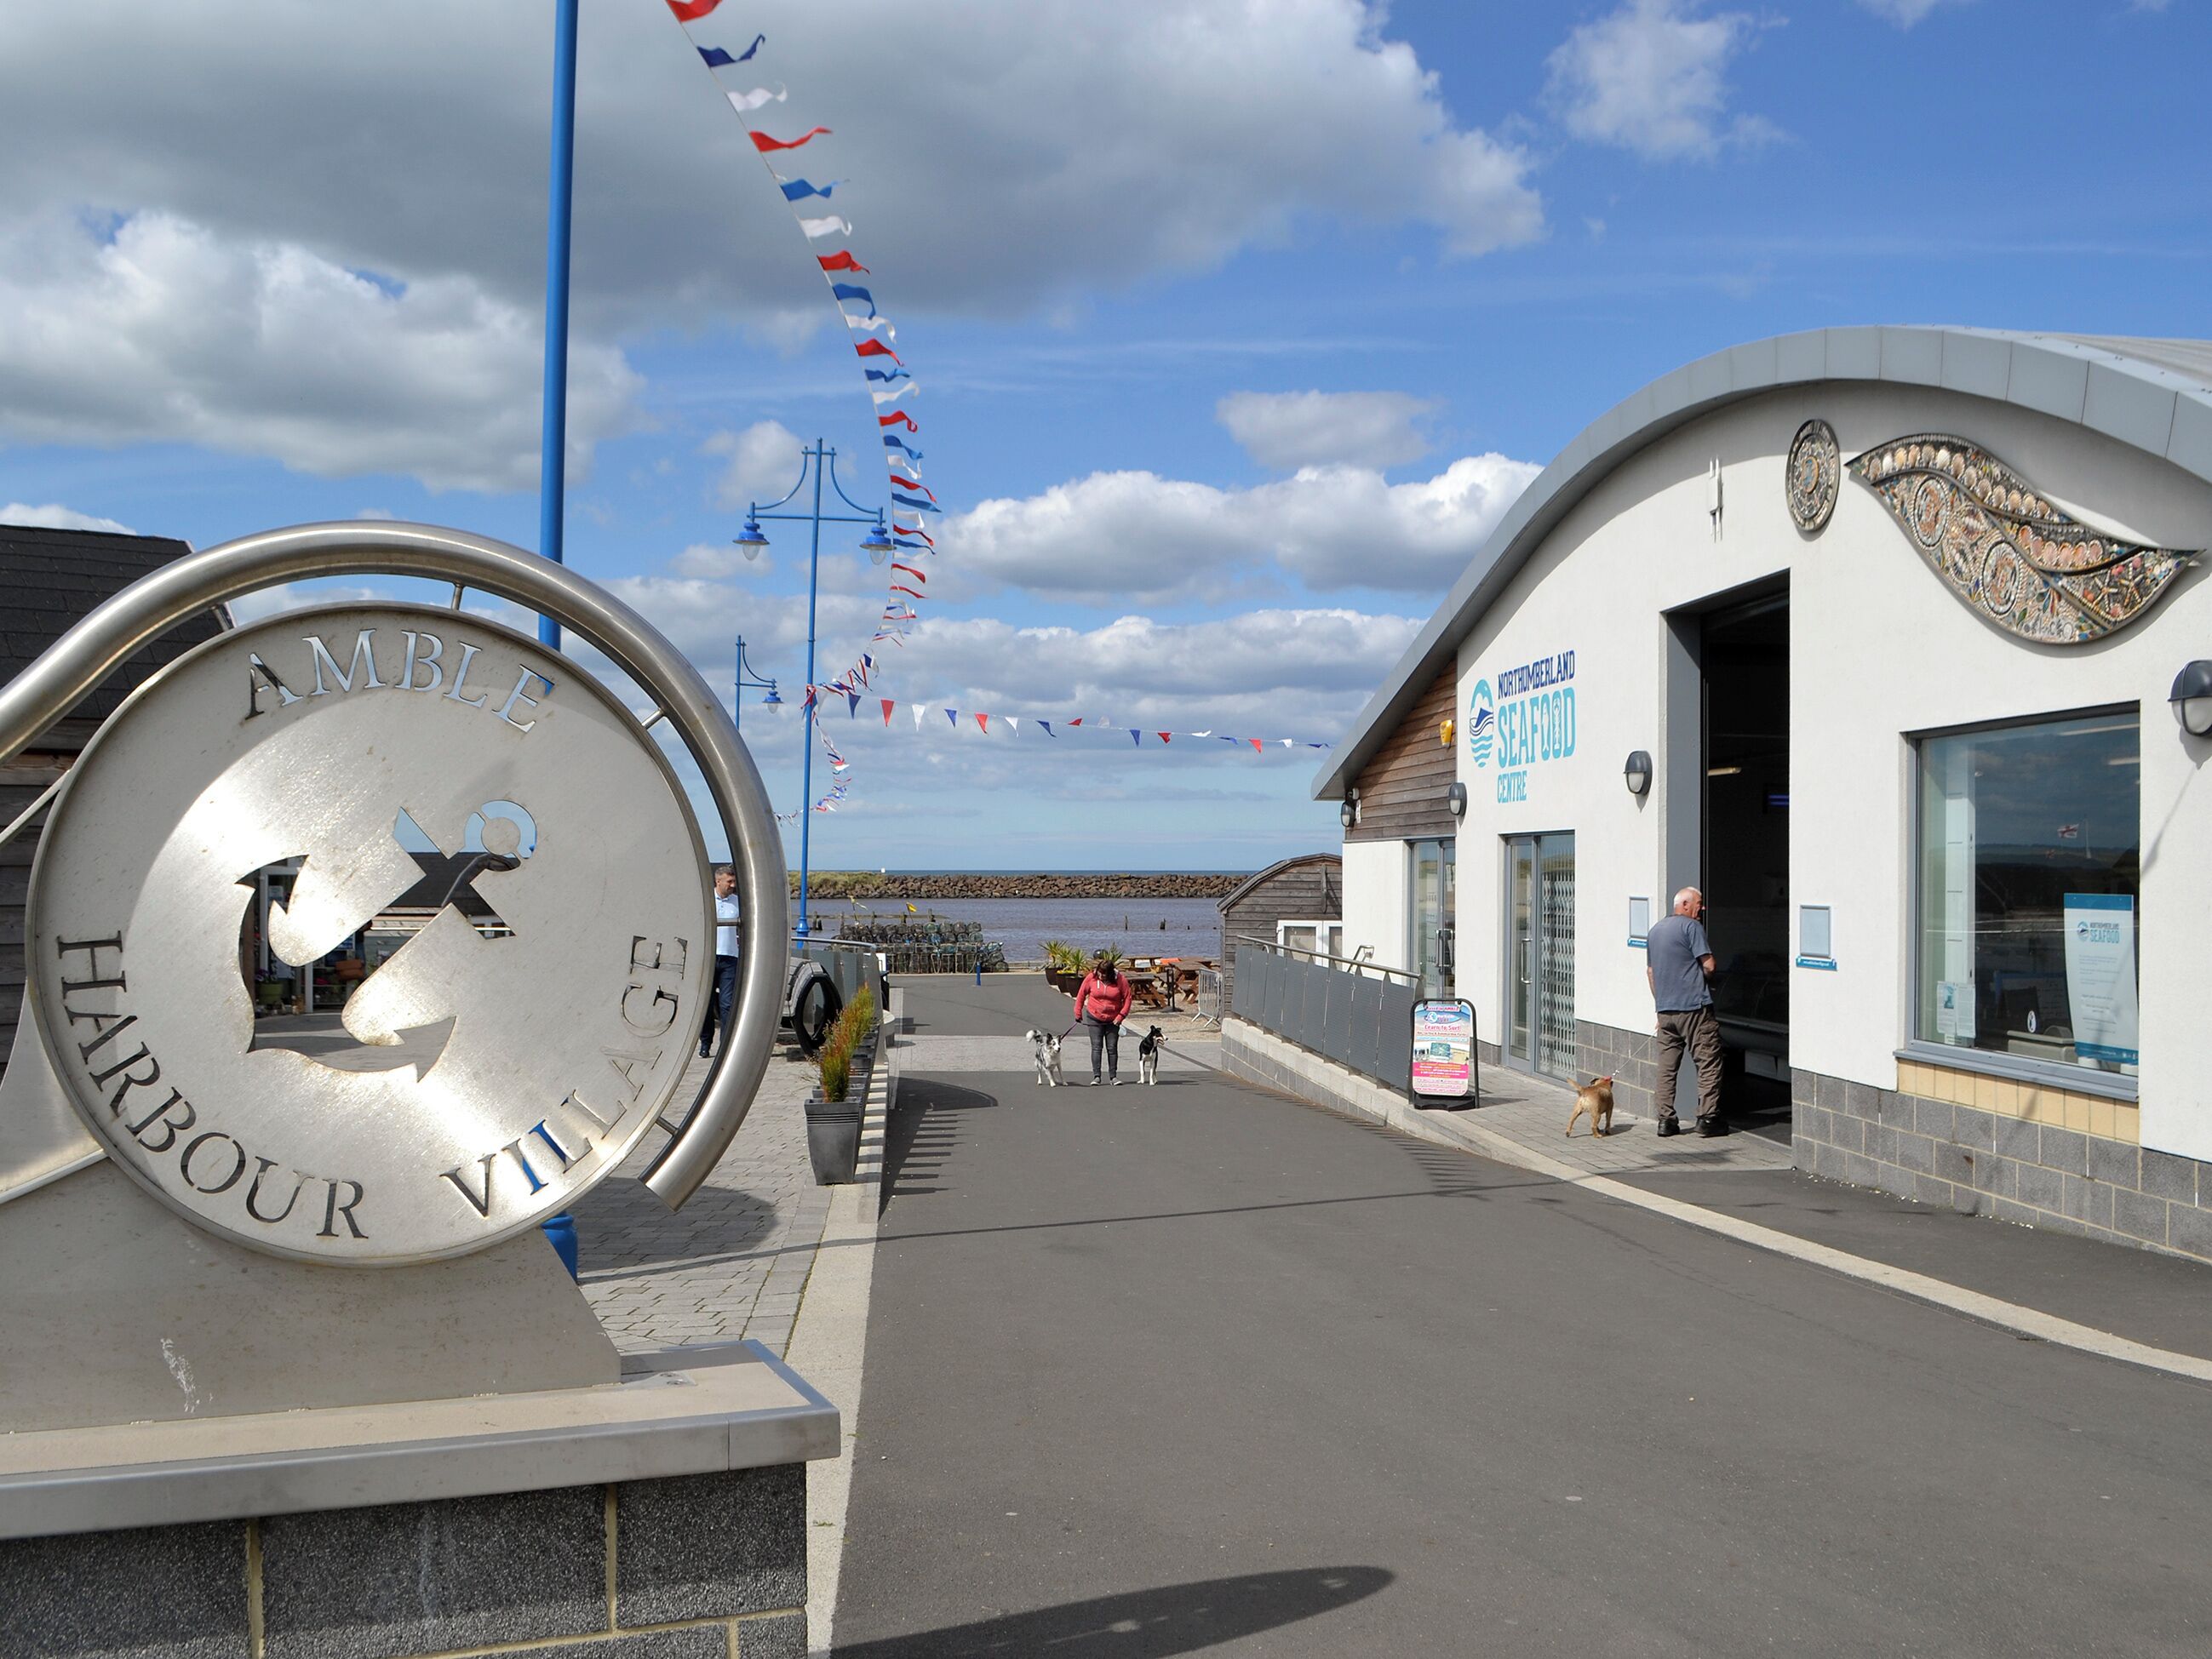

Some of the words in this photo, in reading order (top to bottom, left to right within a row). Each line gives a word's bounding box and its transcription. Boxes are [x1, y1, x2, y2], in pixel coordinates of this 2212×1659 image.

[244, 627, 556, 734] AMBLE
[1498, 649, 1576, 700] NORTHUMBERLAND
[1498, 686, 1577, 769] SEAFOOD
[1497, 769, 1527, 804] CENTRE
[2089, 929, 2120, 944] SEAFOOD
[57, 930, 369, 1239] HARBOUR
[441, 934, 689, 1218] VILLAGE
